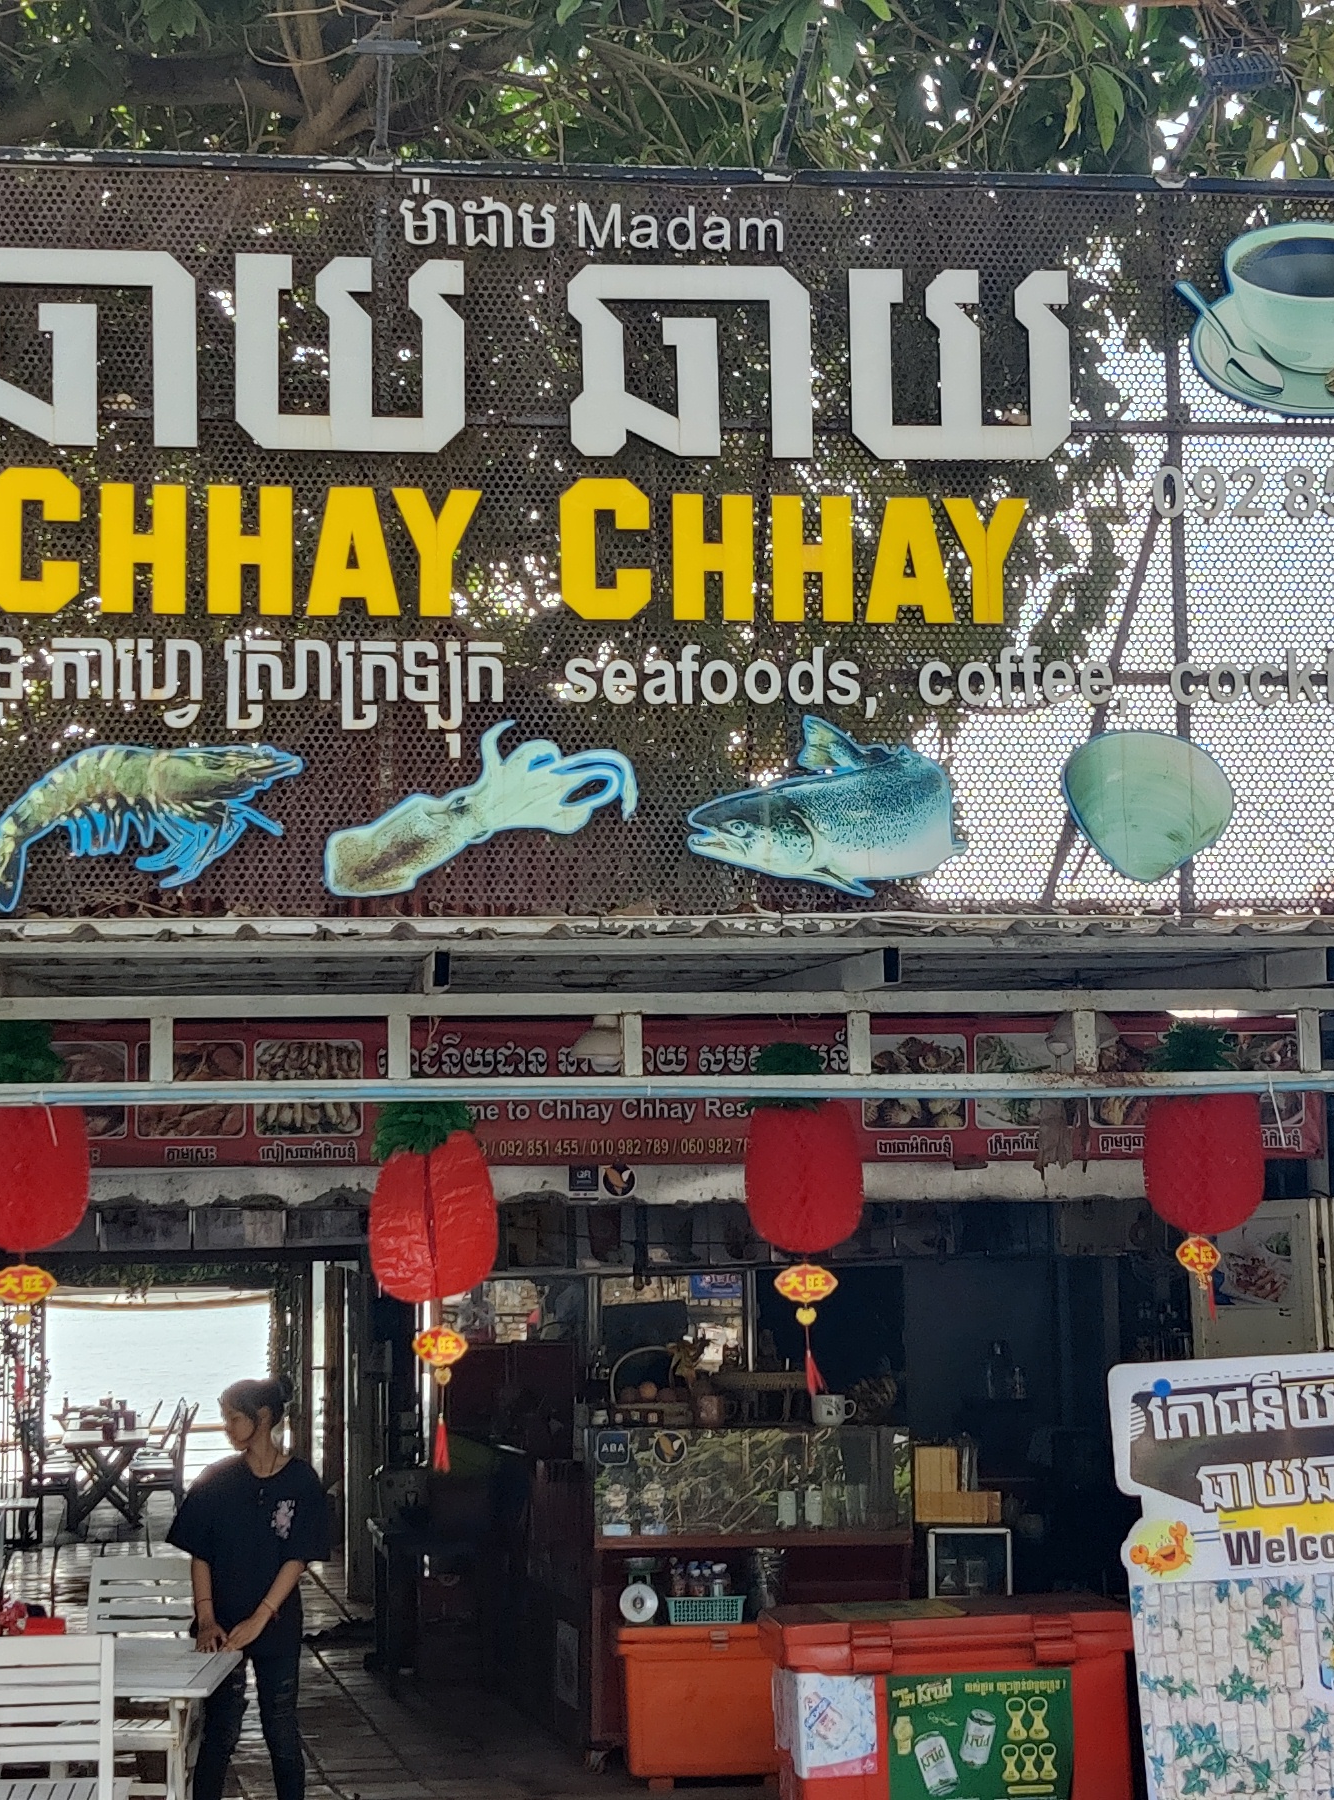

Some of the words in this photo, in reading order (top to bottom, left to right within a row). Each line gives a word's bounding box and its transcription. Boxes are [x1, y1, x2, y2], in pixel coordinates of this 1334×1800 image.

[577, 203, 785, 253] Madam
[567, 264, 1071, 461] ឆាយ
[1153, 465, 1265, 519] 092
[560, 478, 1029, 625] CHHAY
[51, 635, 204, 730] កាហ្វេ
[224, 637, 505, 758] ស្រាក្រឡុក
[563, 644, 877, 719] seafoods,
[918, 645, 1127, 717] coffee,
[507, 1101, 531, 1120] to
[537, 1099, 614, 1125] Chhay
[621, 1098, 697, 1125] Chhay
[499, 1140, 525, 1157] 092
[527, 1140, 551, 1157] 851
[553, 1140, 580, 1157] 455
[590, 1139, 615, 1156] 010
[617, 1139, 642, 1156] 982
[643, 1138, 669, 1156] 789
[680, 1138, 706, 1156] 060
[708, 1138, 733, 1155] 982
[782, 1272, 830, 1293] 大旺
[421, 1334, 459, 1356] 大旺
